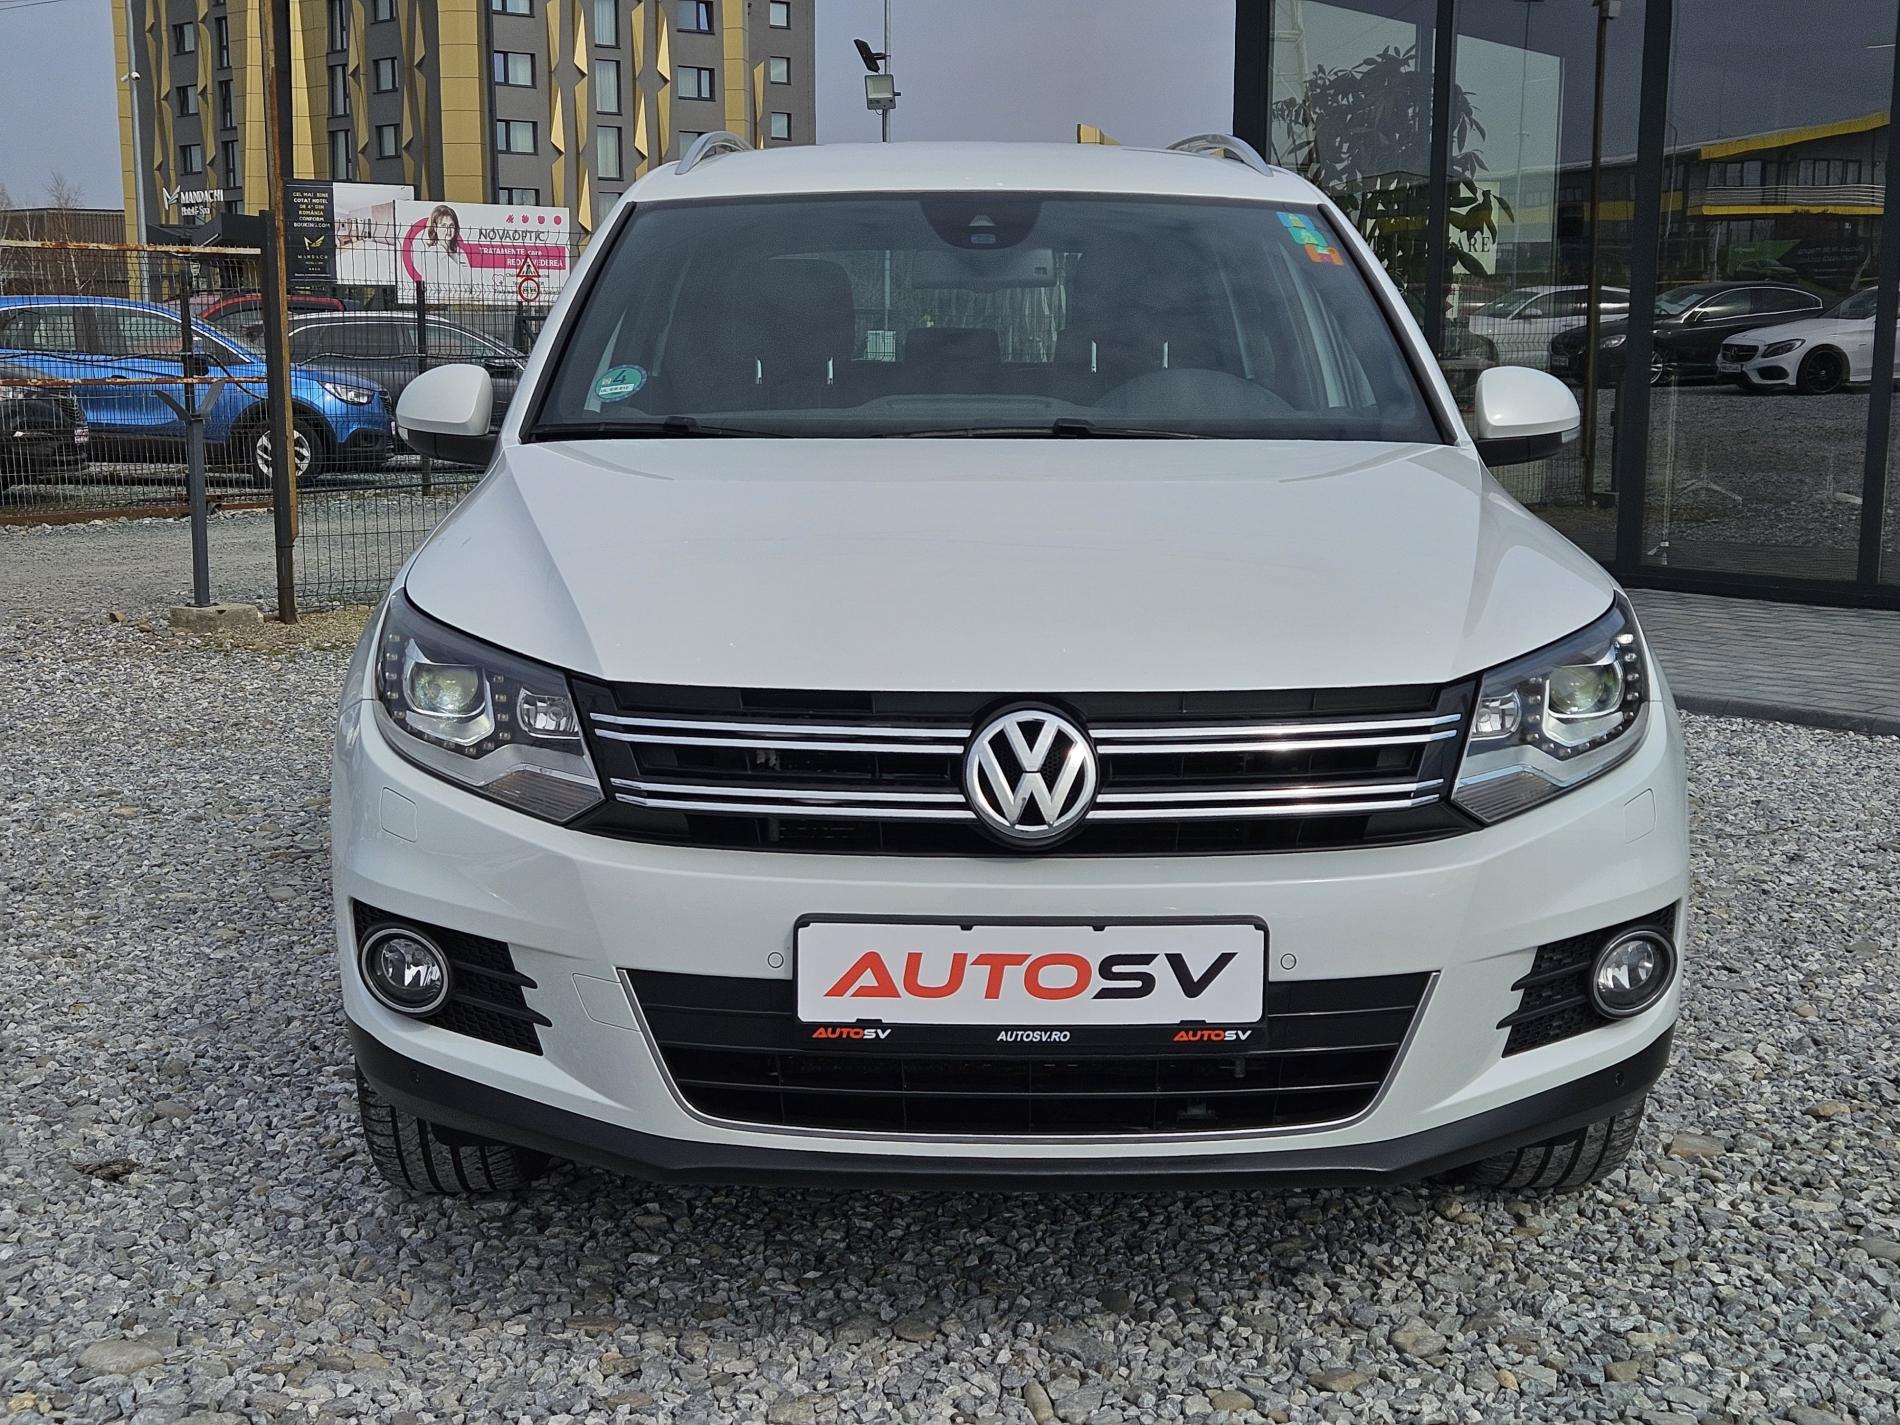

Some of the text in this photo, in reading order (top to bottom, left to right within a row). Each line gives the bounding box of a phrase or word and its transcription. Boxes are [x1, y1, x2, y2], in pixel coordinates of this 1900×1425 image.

[180, 189, 224, 204] MANDACHI
[199, 205, 211, 216] Spa
[479, 229, 545, 241] NOVAOPTIC
[479, 247, 525, 255] TRATAMENTE
[533, 259, 563, 267] VEDEREA
[823, 951, 1239, 1000] AUTOSV
[811, 1027, 892, 1039] AUTOSV
[997, 1030, 1071, 1043] AUTOSV.RO
[1172, 1030, 1252, 1042] AUTOSV
